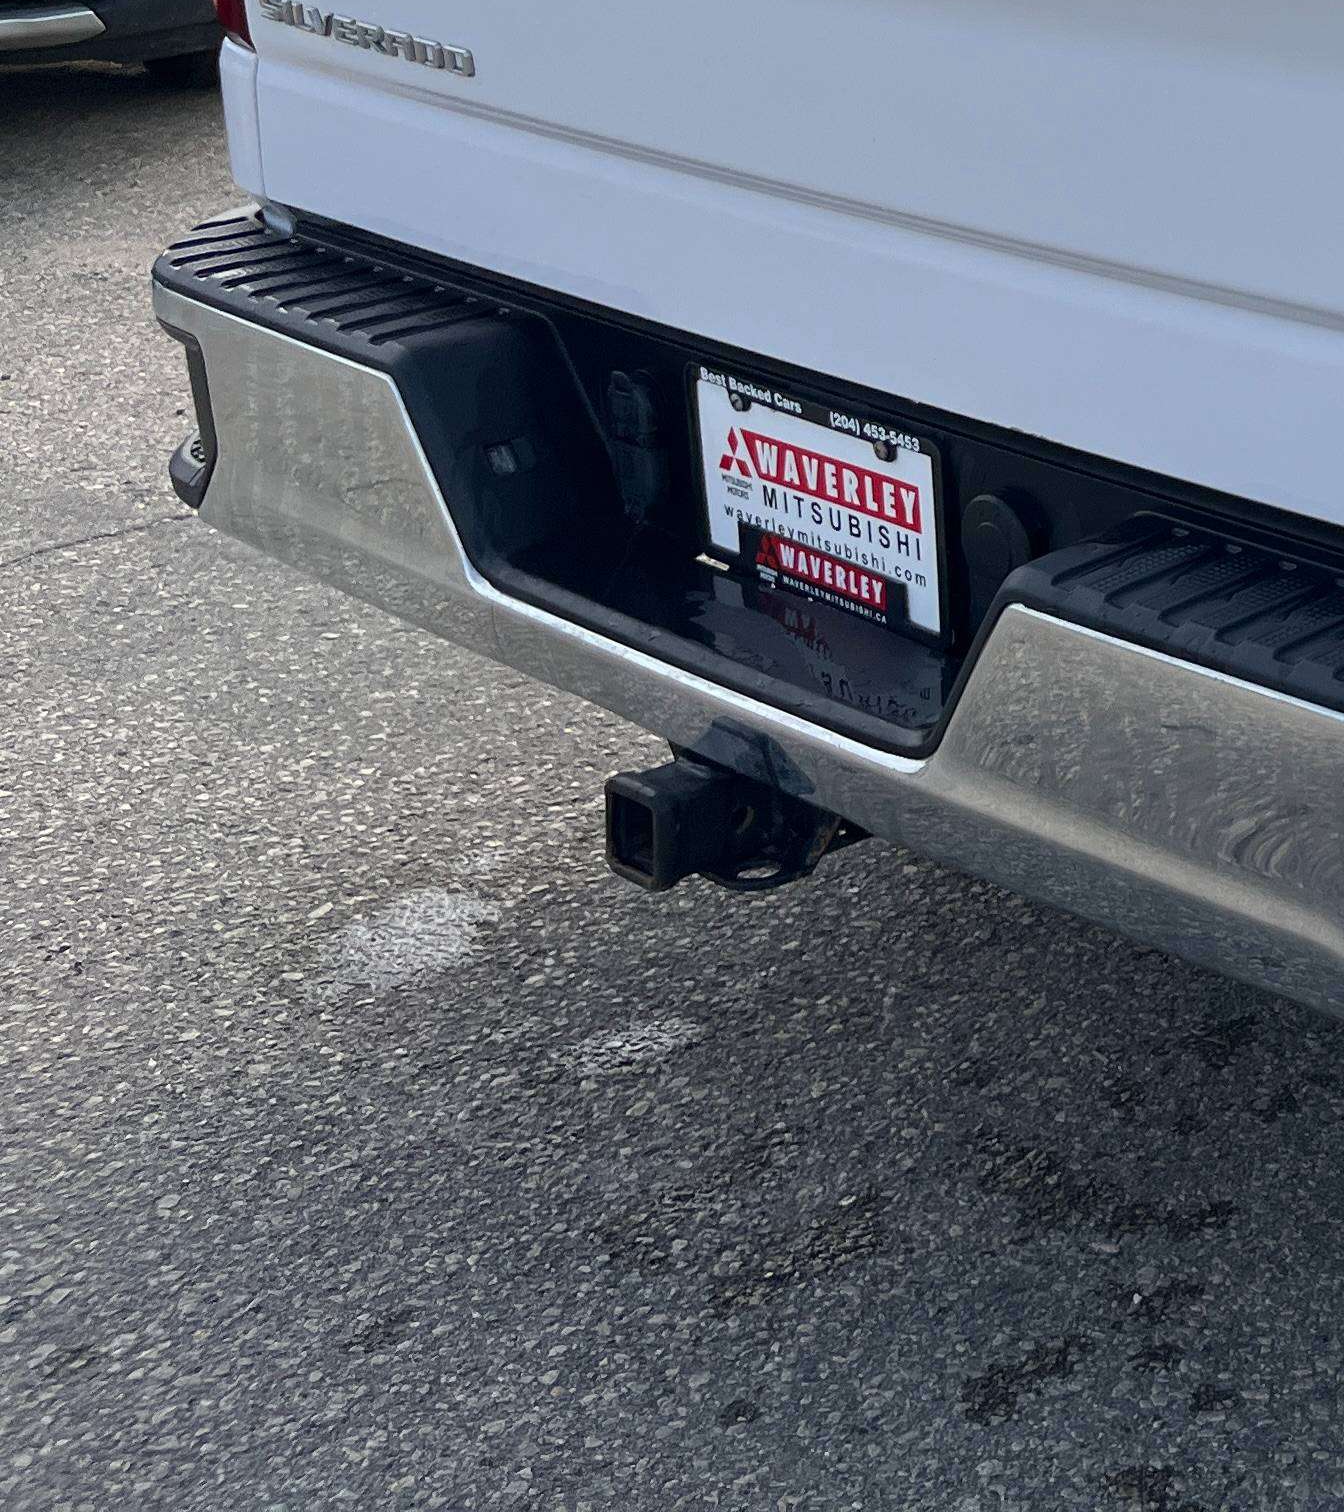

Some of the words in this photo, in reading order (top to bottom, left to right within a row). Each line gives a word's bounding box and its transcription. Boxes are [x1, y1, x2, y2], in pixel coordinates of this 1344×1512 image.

[699, 366, 726, 387] Best
[728, 376, 772, 404] Backed
[773, 393, 802, 414] Cars
[829, 411, 861, 436] (204)
[863, 423, 920, 453] 453-5453
[755, 439, 917, 526] WAVERLEY
[724, 504, 927, 588] waverleymitsubishi.com
[763, 485, 922, 561] MITSUBISHI
[779, 542, 883, 605] WAVERLEY
